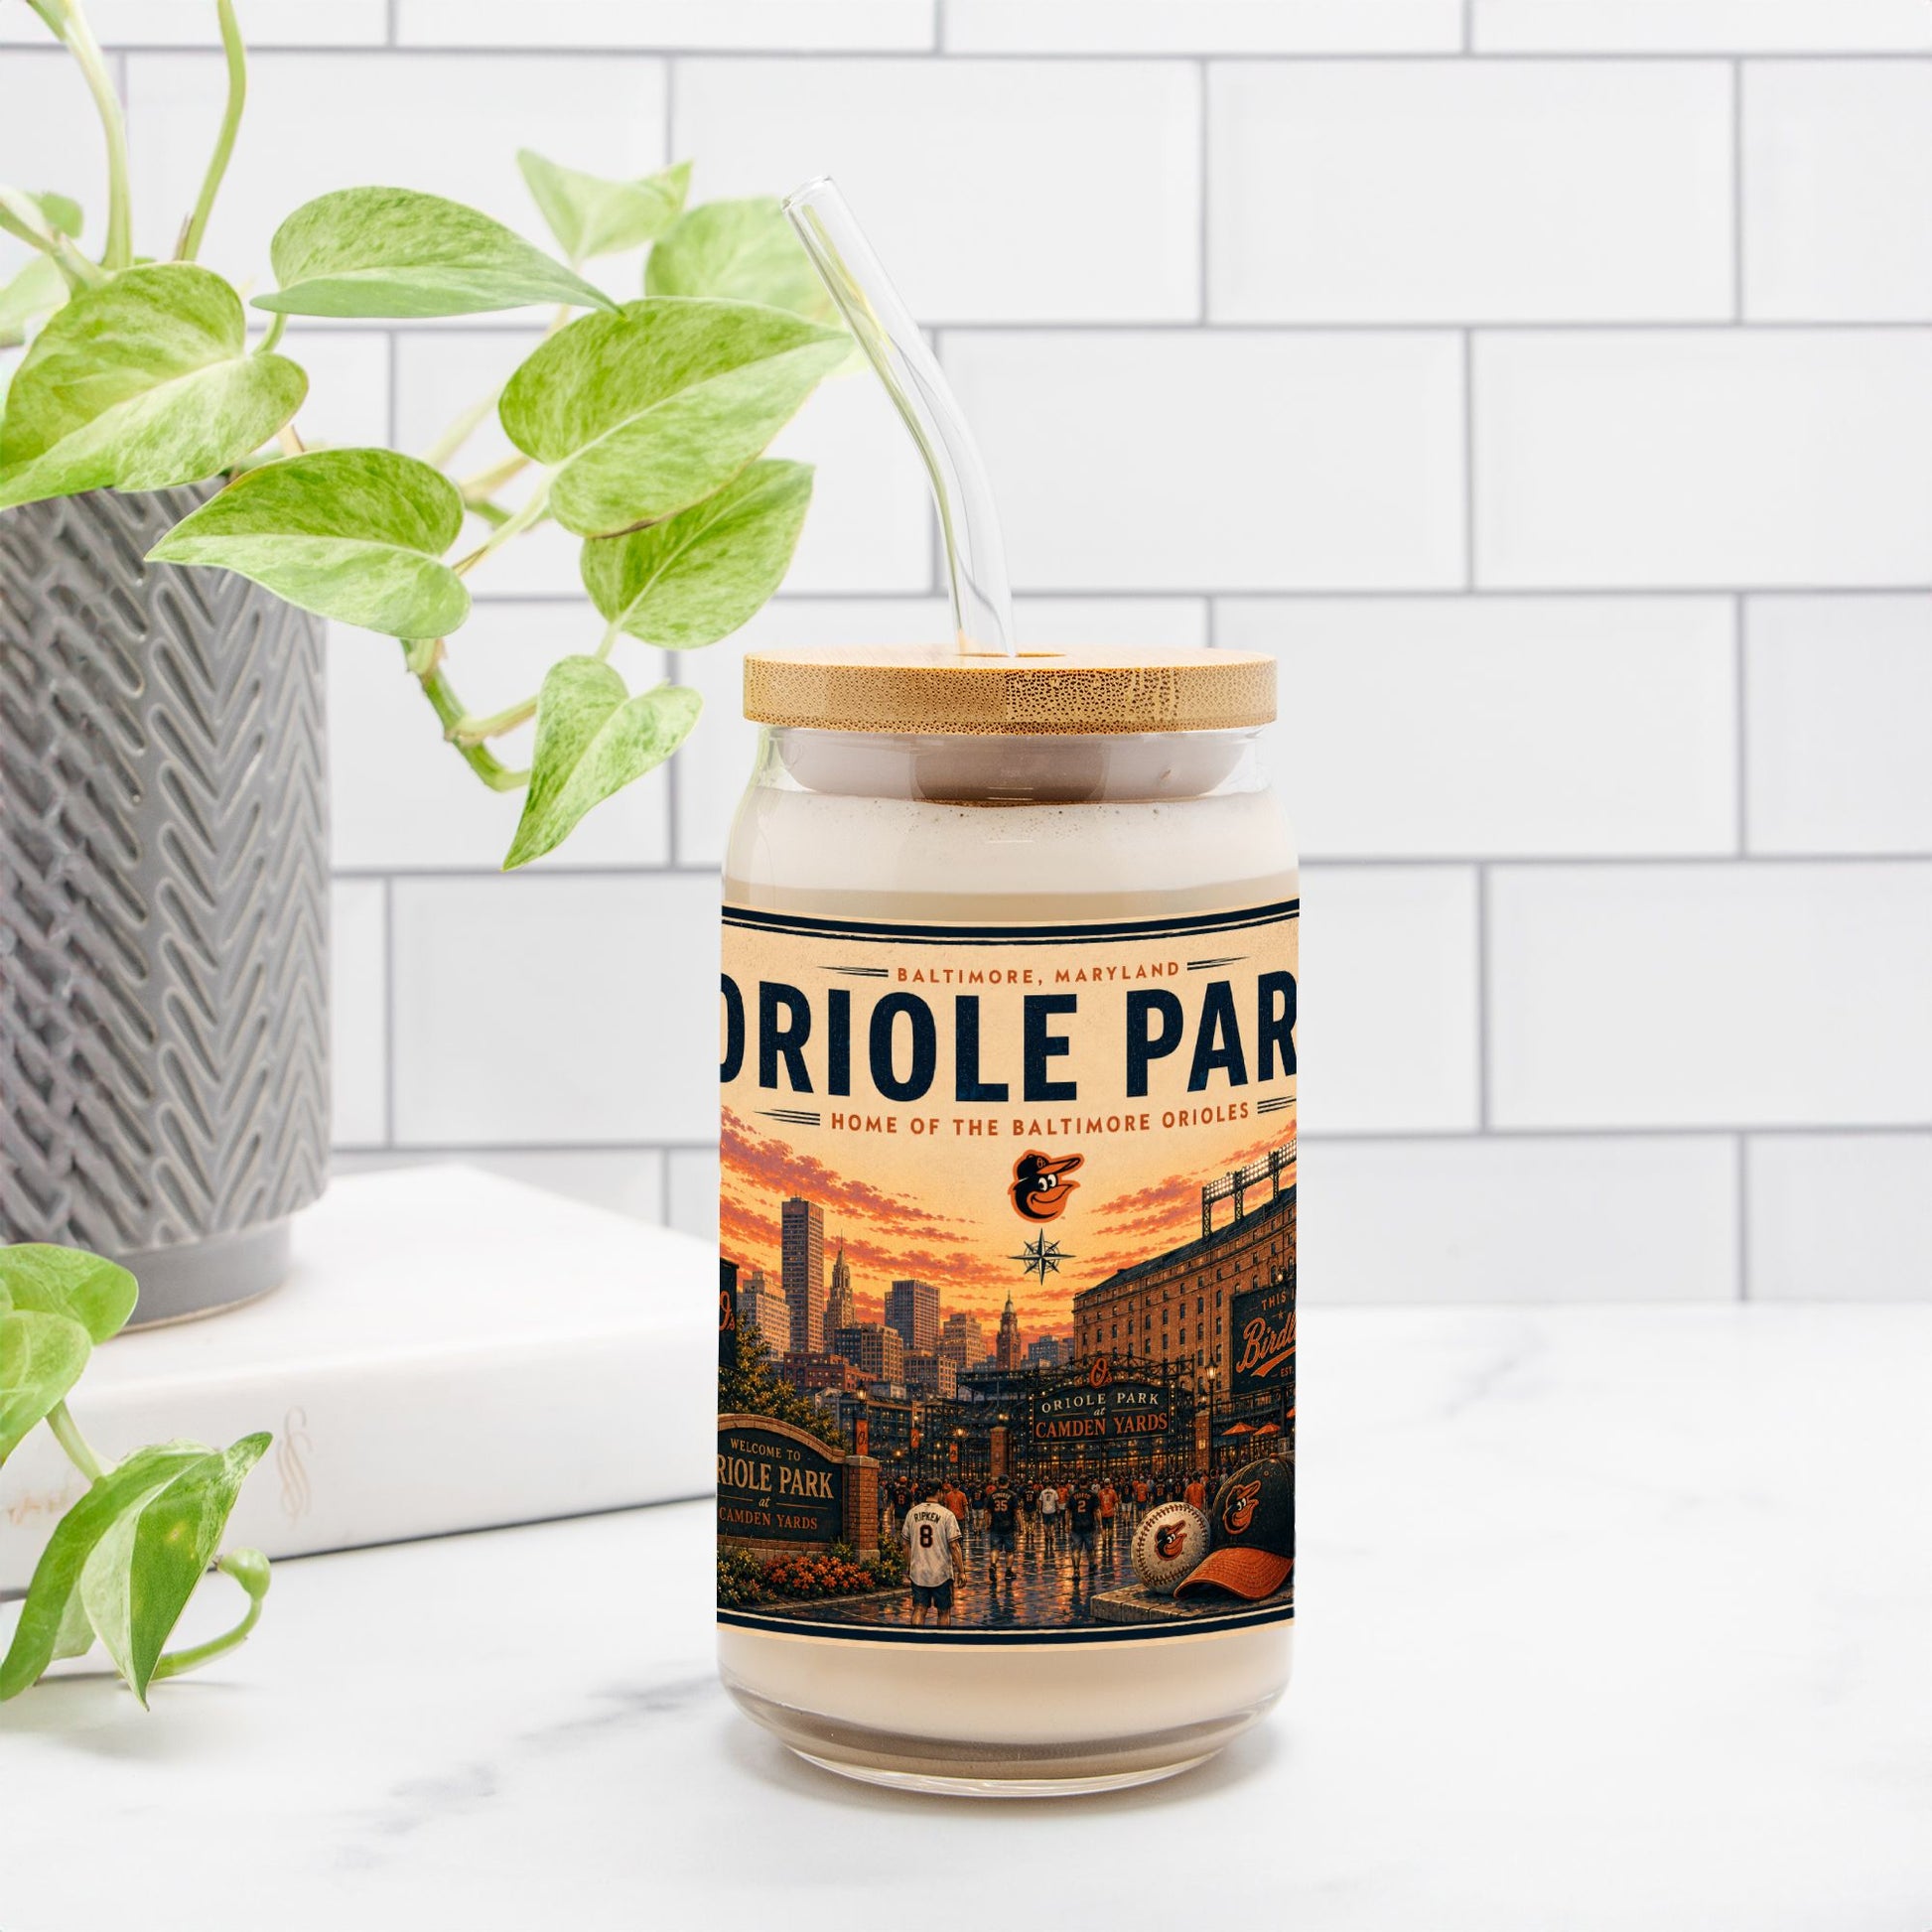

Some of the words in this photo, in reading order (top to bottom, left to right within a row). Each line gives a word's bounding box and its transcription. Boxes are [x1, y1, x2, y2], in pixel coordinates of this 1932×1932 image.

[897, 967, 1042, 985] BALTIMORE,
[1055, 962, 1179, 982] MARYLAND
[831, 1113, 897, 1134] HOME
[910, 1118, 940, 1135] OF
[953, 1119, 998, 1136] THE
[1013, 1113, 1150, 1136] BALTIMORE
[1162, 1102, 1249, 1129] ORIOLES
[1262, 1290, 1287, 1311] THIS
[1041, 1393, 1106, 1413] ORIOLE
[1117, 1392, 1160, 1405] PARK
[1093, 1407, 1106, 1417] at
[1035, 1418, 1106, 1439] CAMDEN
[1113, 1412, 1169, 1435] YARDS
[730, 1438, 782, 1459] WELCOME
[787, 1449, 800, 1461] TO
[779, 1466, 834, 1499] PARK
[759, 1496, 770, 1508] at
[994, 1499, 1009, 1512] 35
[1077, 1500, 1086, 1513] 2
[719, 1506, 771, 1527] CAMDEN
[776, 1514, 818, 1530] YARDS
[913, 1511, 941, 1525] RIPKEN
[919, 1524, 933, 1549] 8
